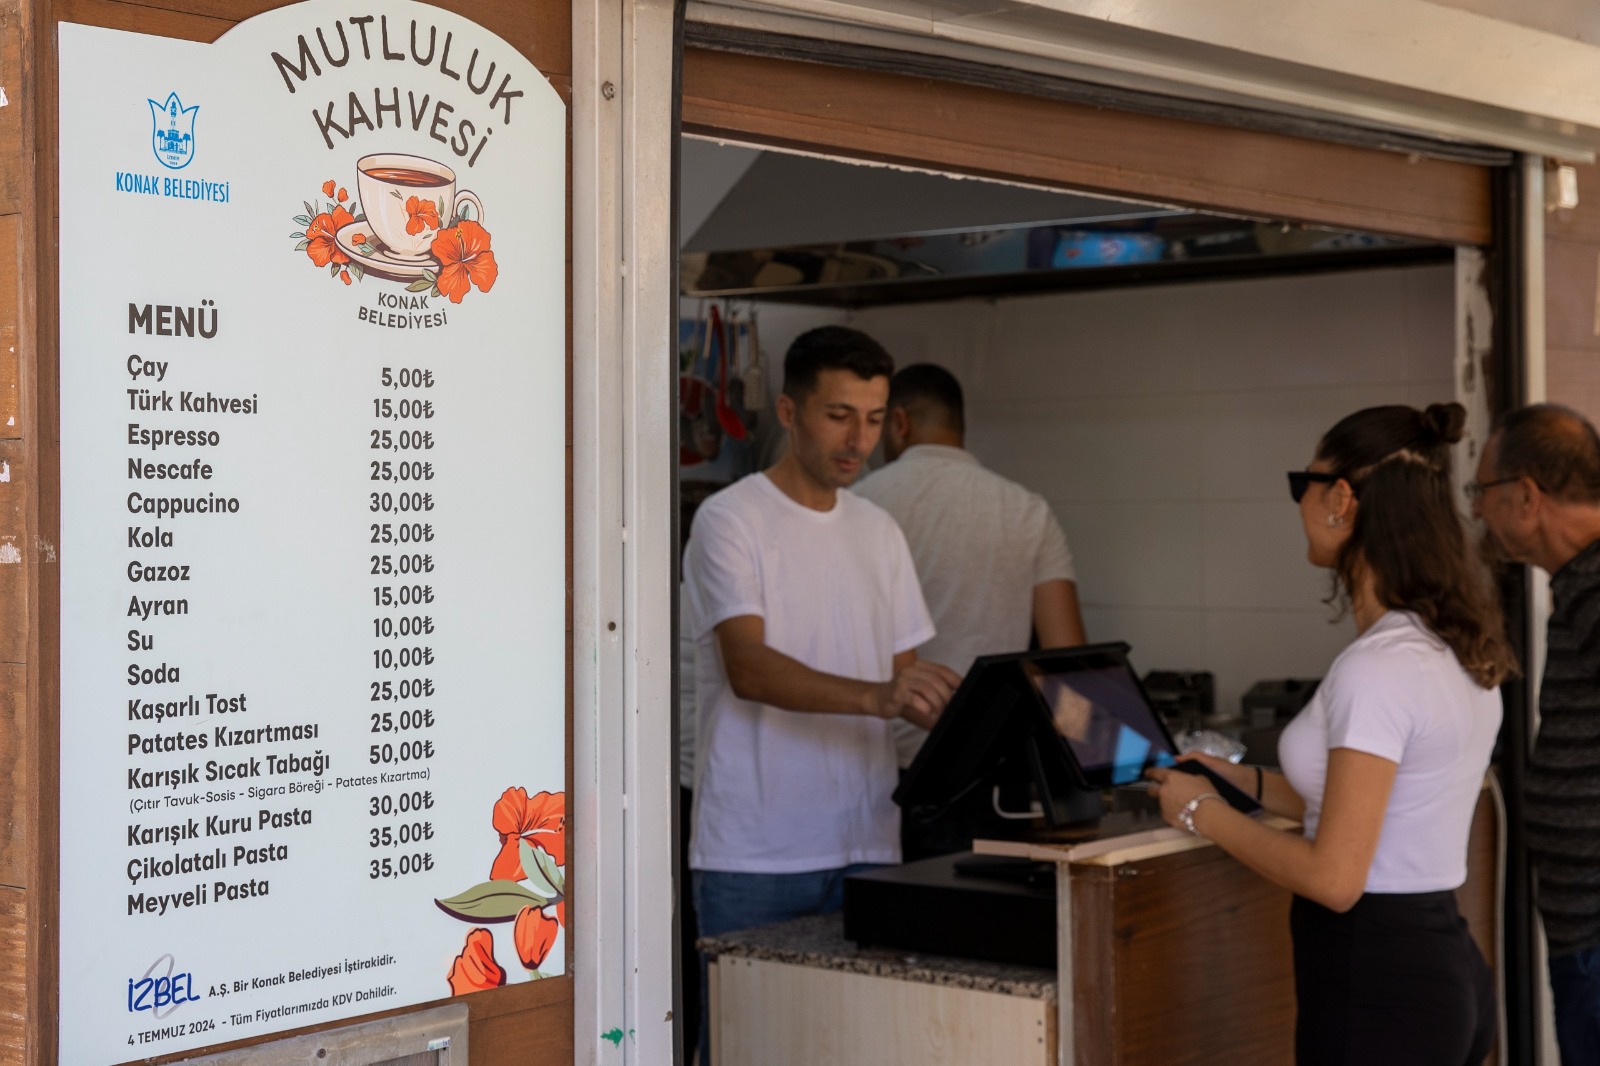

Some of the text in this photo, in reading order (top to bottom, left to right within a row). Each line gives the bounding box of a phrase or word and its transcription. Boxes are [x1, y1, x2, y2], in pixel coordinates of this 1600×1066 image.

[270, 14, 525, 125] MUTLULUK
[311, 87, 493, 168] KAHVESİ
[115, 172, 230, 203] KONAK BELEDİYESİ
[128, 299, 218, 339] MENÜ
[357, 306, 448, 329] BELEDİYESİ
[377, 292, 430, 309] KONAK
[126, 354, 435, 390] Çay 5,00₺
[126, 389, 435, 421] Türk Kahvesi 15,00₺
[127, 424, 435, 452] Espresso 25,00₺
[127, 458, 435, 483] Nescafe 25,00₺
[126, 492, 435, 519] Cappucino 30,00₺
[127, 523, 435, 547] Kola 25,00₺
[126, 554, 435, 582] Gazoz 25,00₺
[126, 585, 435, 621] Ayran 15,00₺
[127, 616, 435, 651] Su 10,00₺
[127, 647, 435, 685] Soda 10,00₺
[128, 678, 436, 723] Kaşarlı Tost 25,00₺
[127, 709, 436, 755] Patates Kızartması 25,00₺
[127, 740, 436, 790] Karışık Sıcak Tabağı 50,00₺
[129, 799, 161, 814] (Çıtır
[163, 790, 236, 807] Tavuk-Sosis
[247, 787, 286, 800] Sigara
[288, 780, 325, 794] Böreği
[335, 776, 378, 788] Patates
[380, 767, 431, 783] Kızartma)
[127, 791, 435, 846] Karışık Kuru Pasta 30,00₺
[126, 822, 435, 885] Çikolatalı Pasta 35,00₺
[127, 853, 435, 916] Meyveli Pasta 35,00₺
[127, 954, 397, 1012] İZBEL A.Ş. Bir Konak Belediyesi İştirakidir.
[127, 1035, 135, 1045] 4
[137, 1024, 186, 1044] TEMMUZ
[188, 1019, 216, 1034] 2024
[229, 1014, 253, 1026] Tüm
[255, 998, 330, 1022] Fiyatlarımızda
[332, 992, 353, 1006] KDV
[355, 985, 397, 1002] Dahildir.
